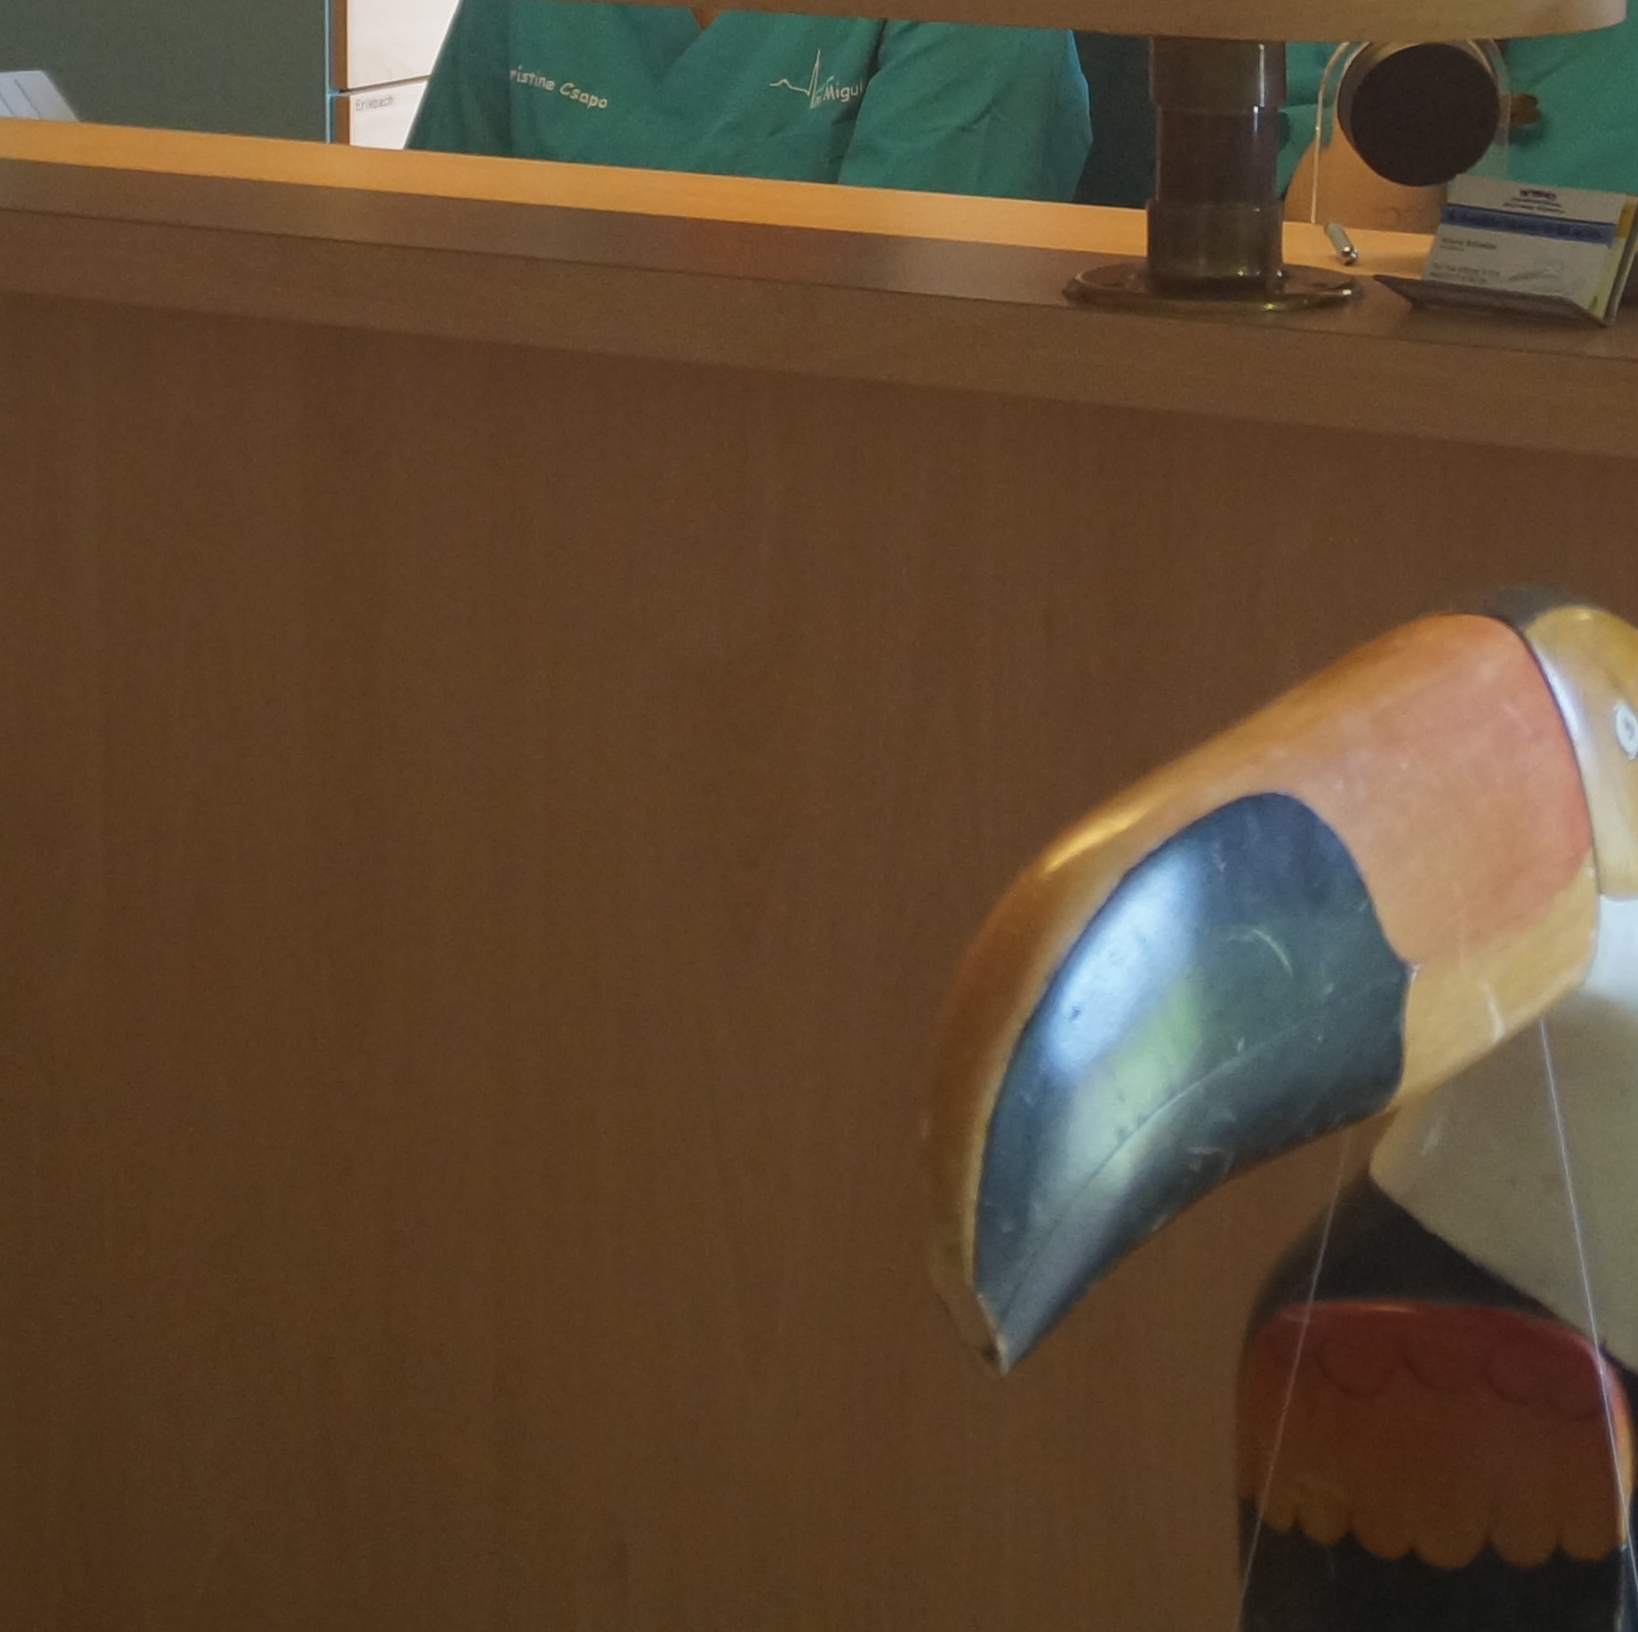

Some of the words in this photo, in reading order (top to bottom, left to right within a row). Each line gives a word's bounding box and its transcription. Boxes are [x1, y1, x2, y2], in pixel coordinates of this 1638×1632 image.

[508, 65, 555, 91] ristine
[559, 82, 608, 109] Csapo
[823, 79, 863, 103] Migul
